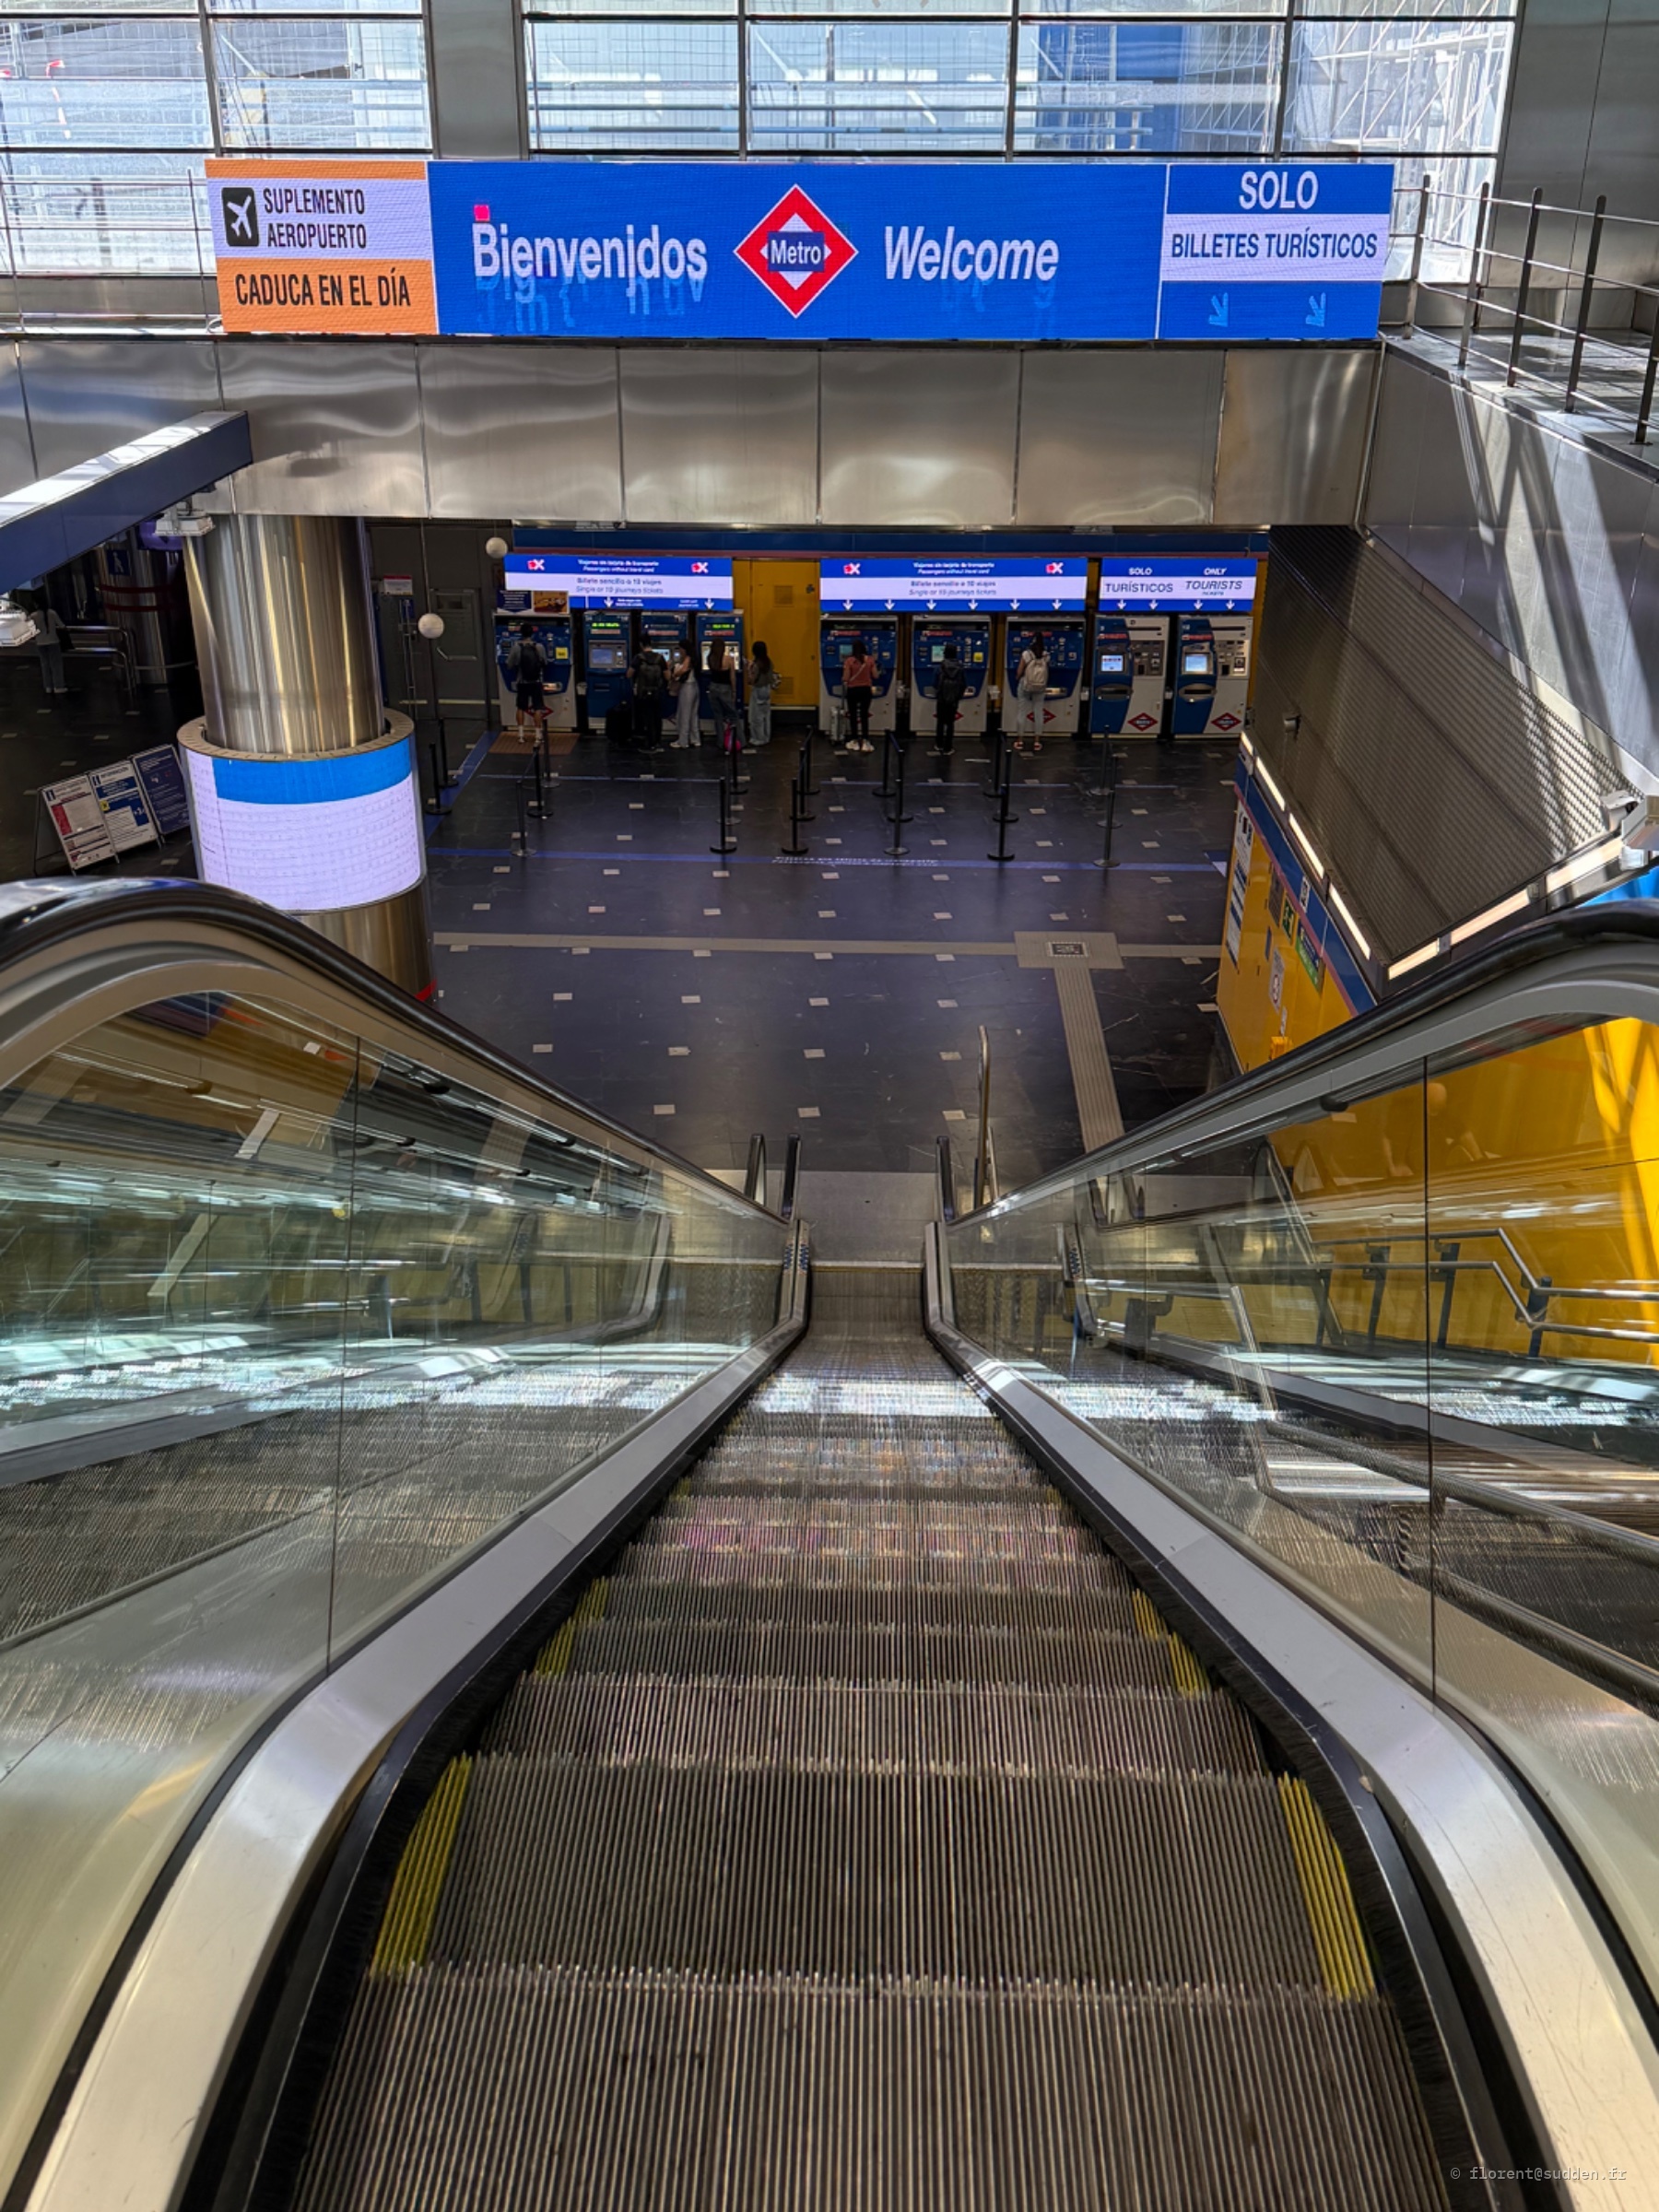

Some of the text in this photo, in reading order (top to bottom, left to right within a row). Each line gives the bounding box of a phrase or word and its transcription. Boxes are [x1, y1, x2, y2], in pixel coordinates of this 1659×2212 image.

[263, 187, 365, 214] SUPLEMENTO
[1239, 171, 1319, 210] SOLO
[267, 223, 367, 249] AEROPUERTO
[1171, 227, 1378, 258] BILLETES TURÍSTICOS
[771, 240, 821, 265] Metro
[885, 226, 1059, 281] Welcome
[235, 267, 411, 306] CADUCA EN EL DÍA
[1128, 567, 1152, 575] SOLO
[1105, 581, 1173, 593] TURÍSTICOS
[1185, 581, 1242, 590] TOURISTS
